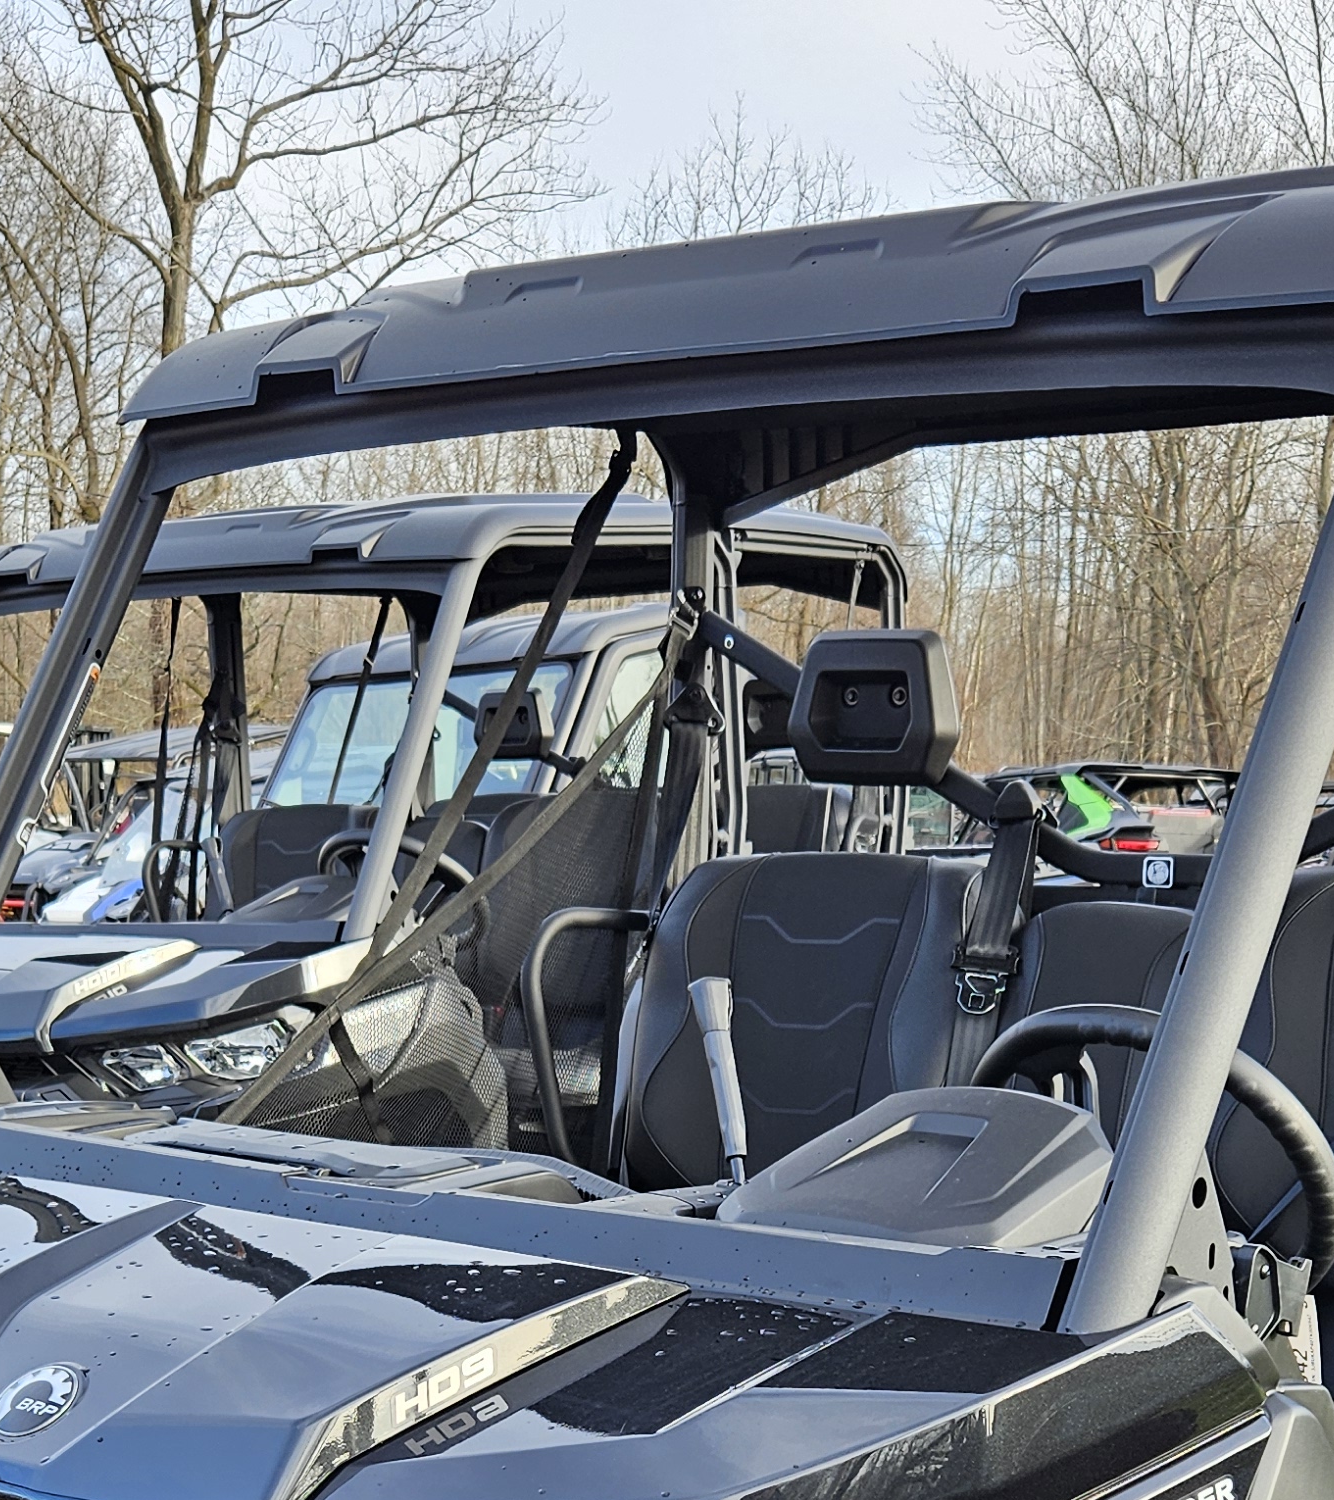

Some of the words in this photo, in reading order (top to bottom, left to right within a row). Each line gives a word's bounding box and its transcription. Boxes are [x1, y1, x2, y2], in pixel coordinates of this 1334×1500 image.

[74, 966, 120, 995] HD10
[395, 1347, 493, 1424] HD9
[15, 1397, 59, 1415] BRP
